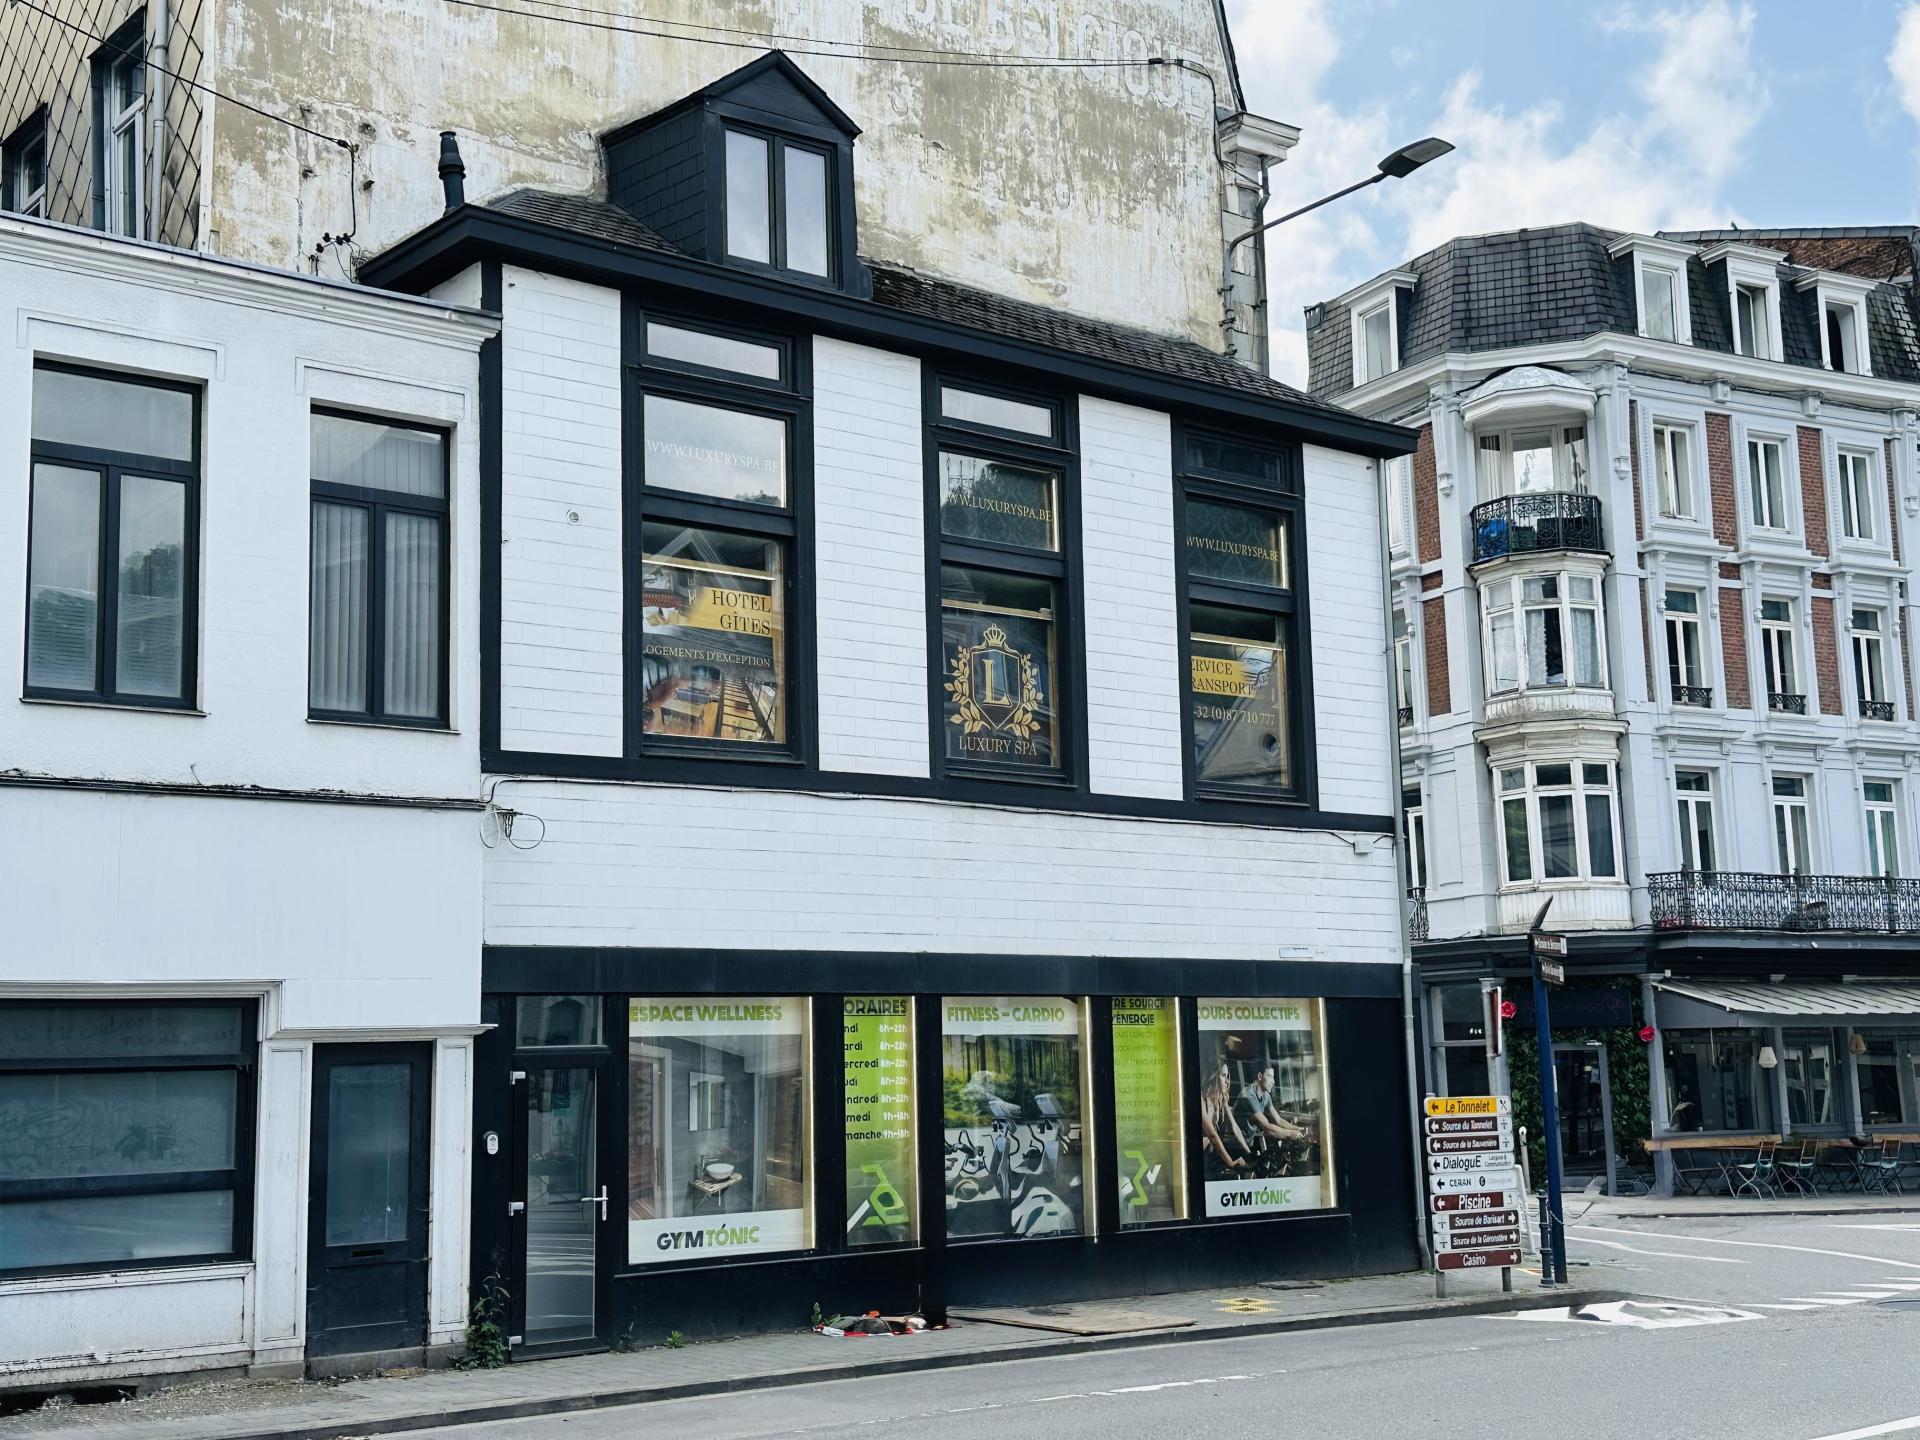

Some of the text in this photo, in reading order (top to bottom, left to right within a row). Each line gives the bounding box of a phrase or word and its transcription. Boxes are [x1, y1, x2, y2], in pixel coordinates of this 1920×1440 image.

[647, 440, 778, 472] WWW.LUXURYSPA.BE
[943, 493, 1053, 522] WW.LUXURYSPA.BE
[711, 589, 771, 613] HOTEL
[719, 611, 771, 635] GÎTES
[643, 644, 771, 667] OGEMENTS D'EXCEPTION
[1192, 658, 1233, 675] ERVICE
[959, 736, 1037, 756] LUXURY SPA
[844, 999, 906, 1014] ORAIRES
[1129, 998, 1166, 1008] SOURCE
[629, 1005, 782, 1022] ESPACE WELLNESS
[947, 1006, 1000, 1022] FITNESS
[1012, 1007, 1065, 1022] CARDIO
[1113, 1011, 1155, 1024] 'ÉNERGIE
[1199, 1006, 1300, 1021] OURS COLLECTIFS
[844, 1023, 858, 1033] ndi
[844, 1040, 863, 1051] ardi
[844, 1058, 879, 1068] ercredi
[844, 1076, 858, 1087] udi
[846, 1093, 879, 1104] ndredi
[1445, 1101, 1490, 1113] Le Tonnelet
[846, 1111, 871, 1122] medi
[1442, 1121, 1461, 1131] Source
[1462, 1120, 1469, 1130] du
[845, 1131, 882, 1141] manche
[1443, 1155, 1482, 1171] DialoguE
[1449, 1178, 1472, 1187] CERAN
[1458, 1194, 1492, 1210] Piscine
[1463, 1254, 1487, 1266] Casino
